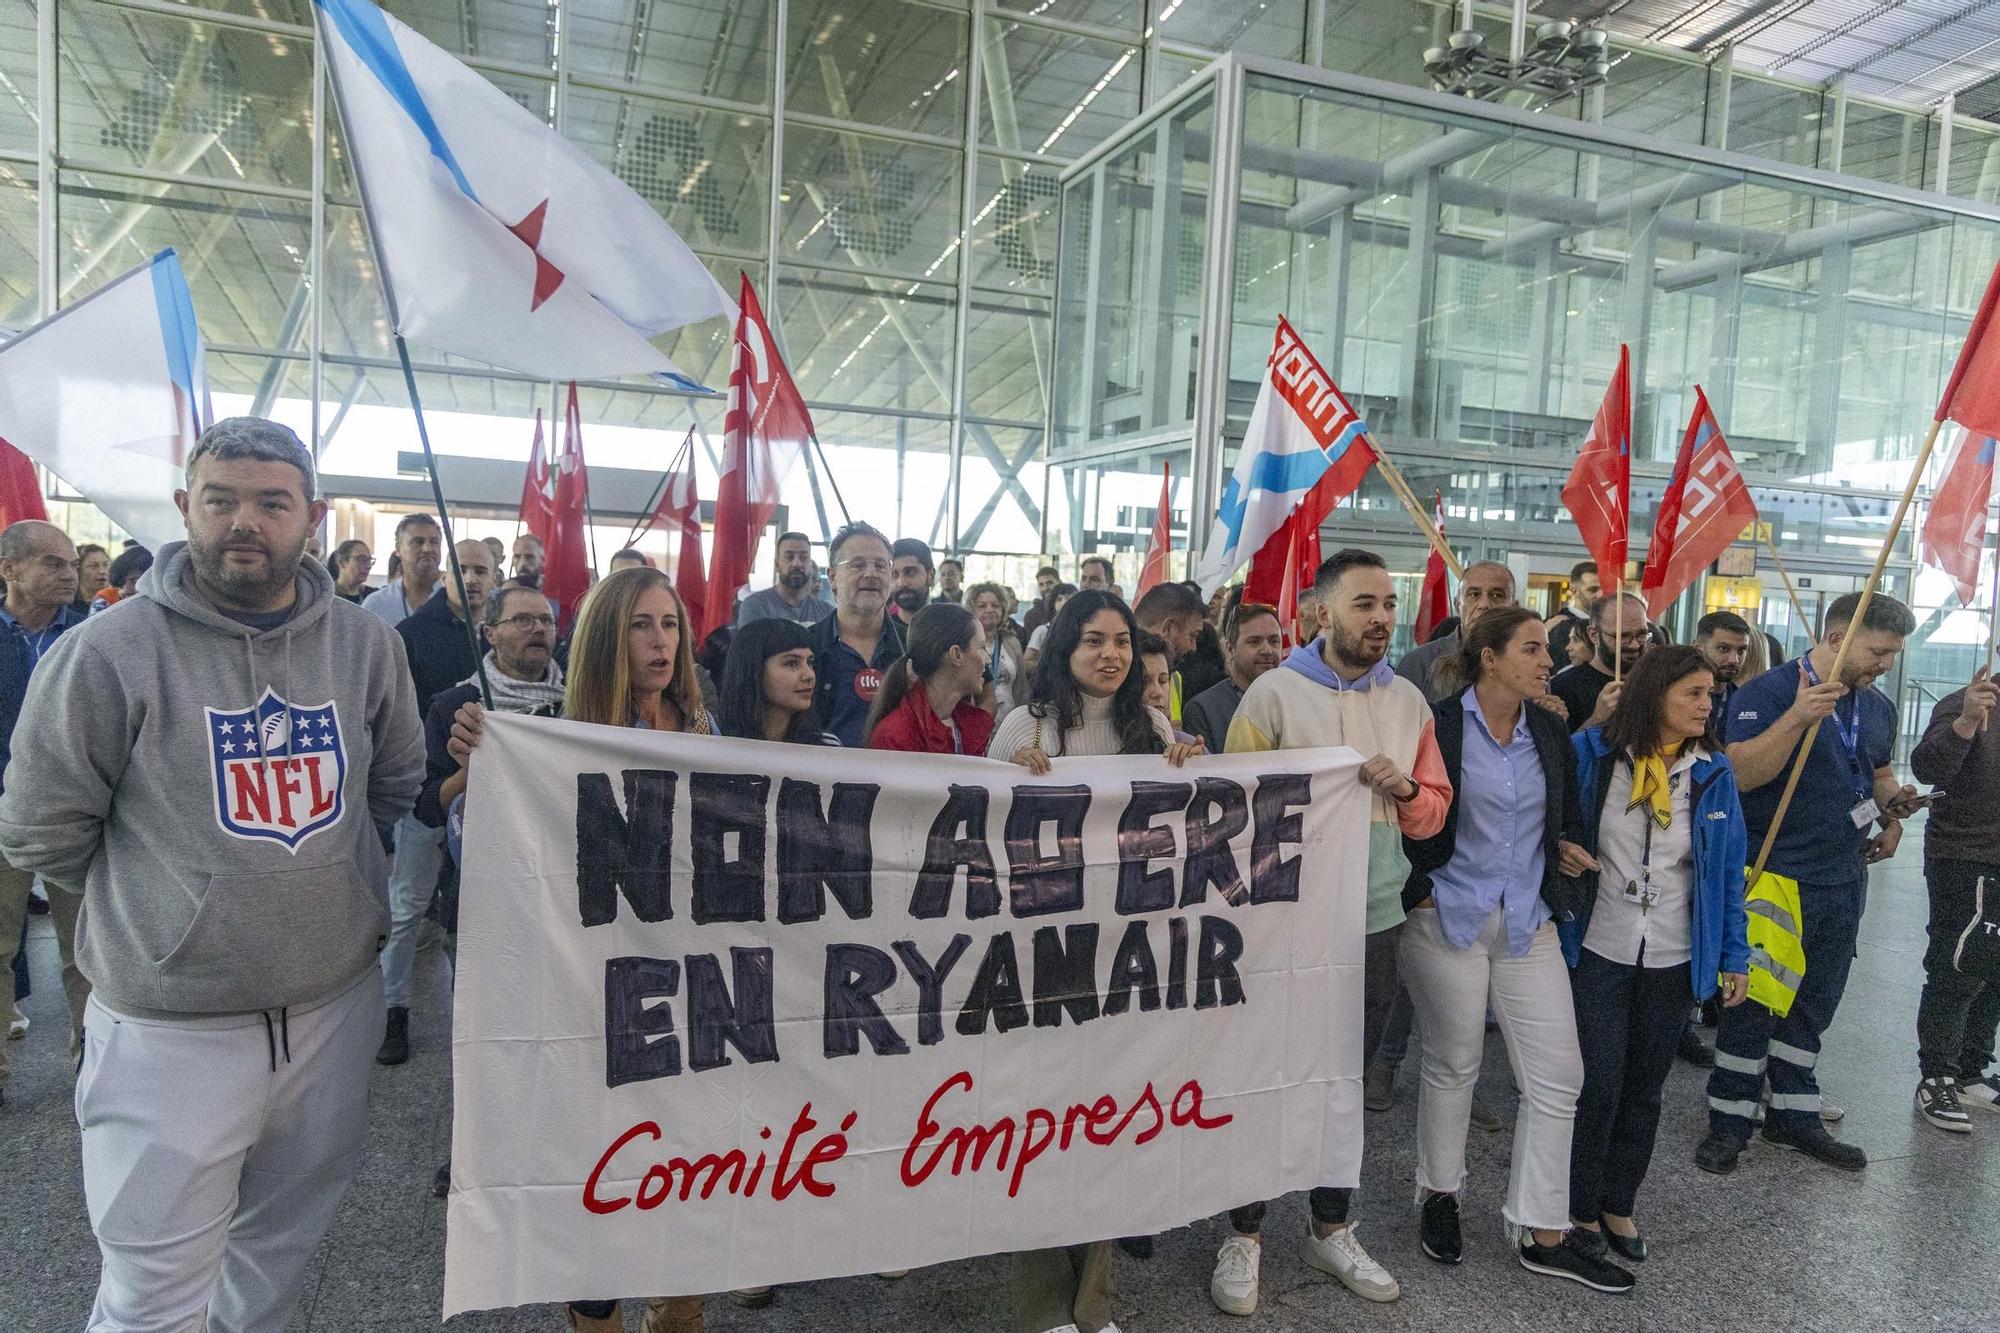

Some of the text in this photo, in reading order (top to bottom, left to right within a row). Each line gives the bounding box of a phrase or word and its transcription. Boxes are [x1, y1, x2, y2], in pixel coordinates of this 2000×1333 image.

[229, 756, 335, 829] NFL
[576, 769, 1313, 927] NON AO ERE
[605, 915, 1246, 1088] EN RYANAIR
[582, 1071, 1233, 1214] Comité Empresa
